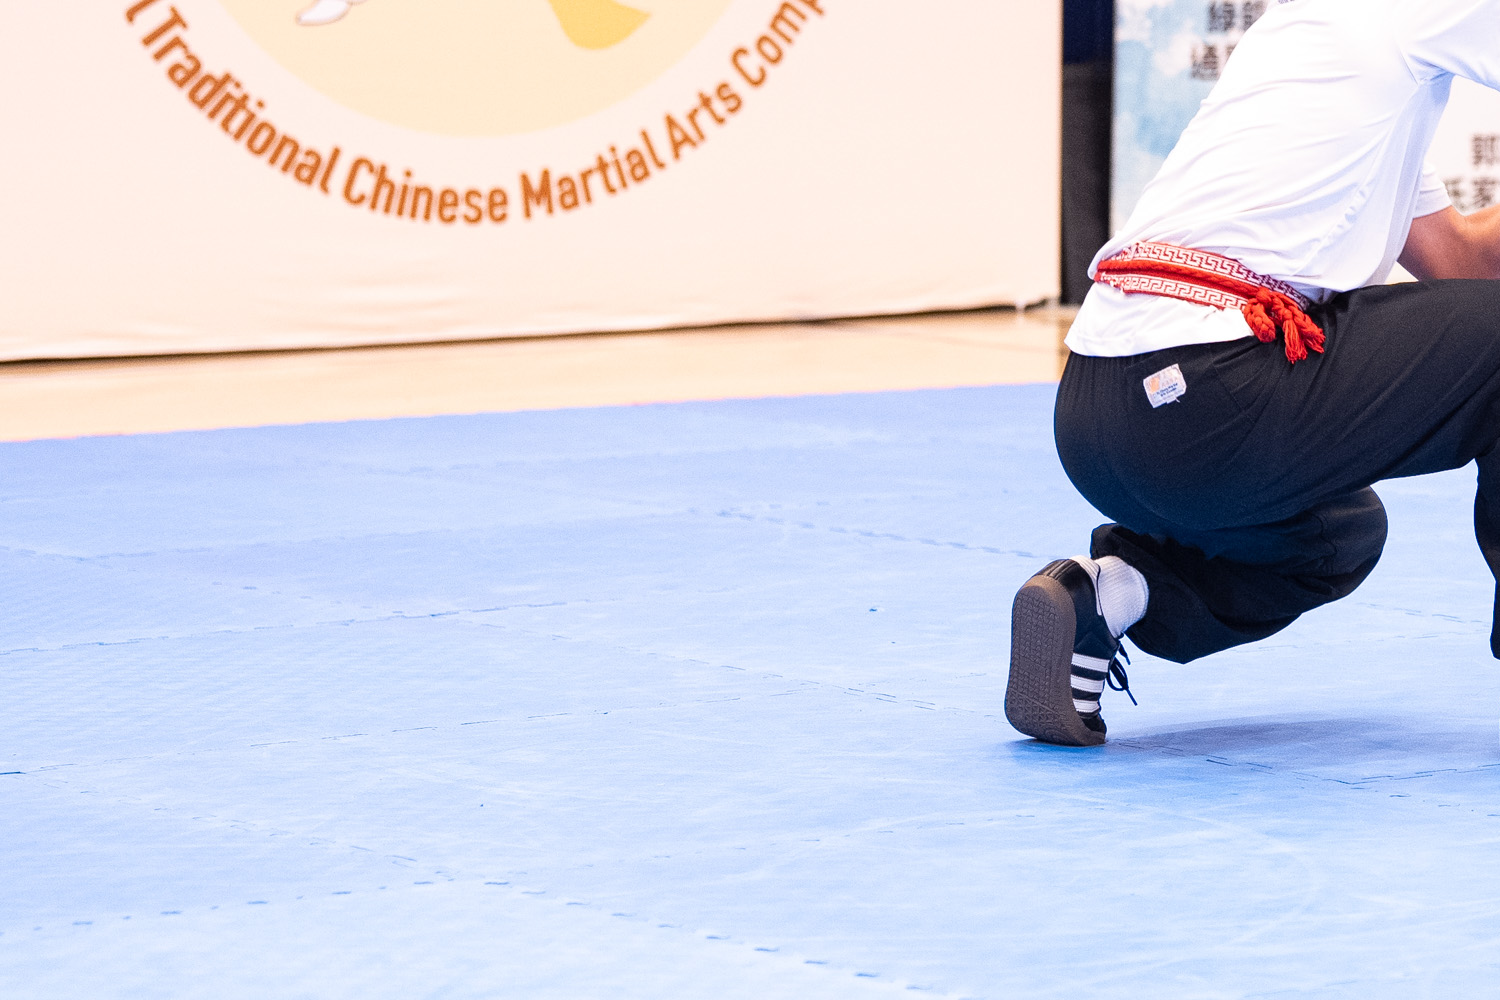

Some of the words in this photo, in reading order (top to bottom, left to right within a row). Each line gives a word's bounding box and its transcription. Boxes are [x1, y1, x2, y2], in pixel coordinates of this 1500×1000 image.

[140, 4, 344, 199] Traditional
[341, 156, 511, 228] Chinese
[518, 128, 667, 222] Martial
[663, 80, 745, 162] Arts
